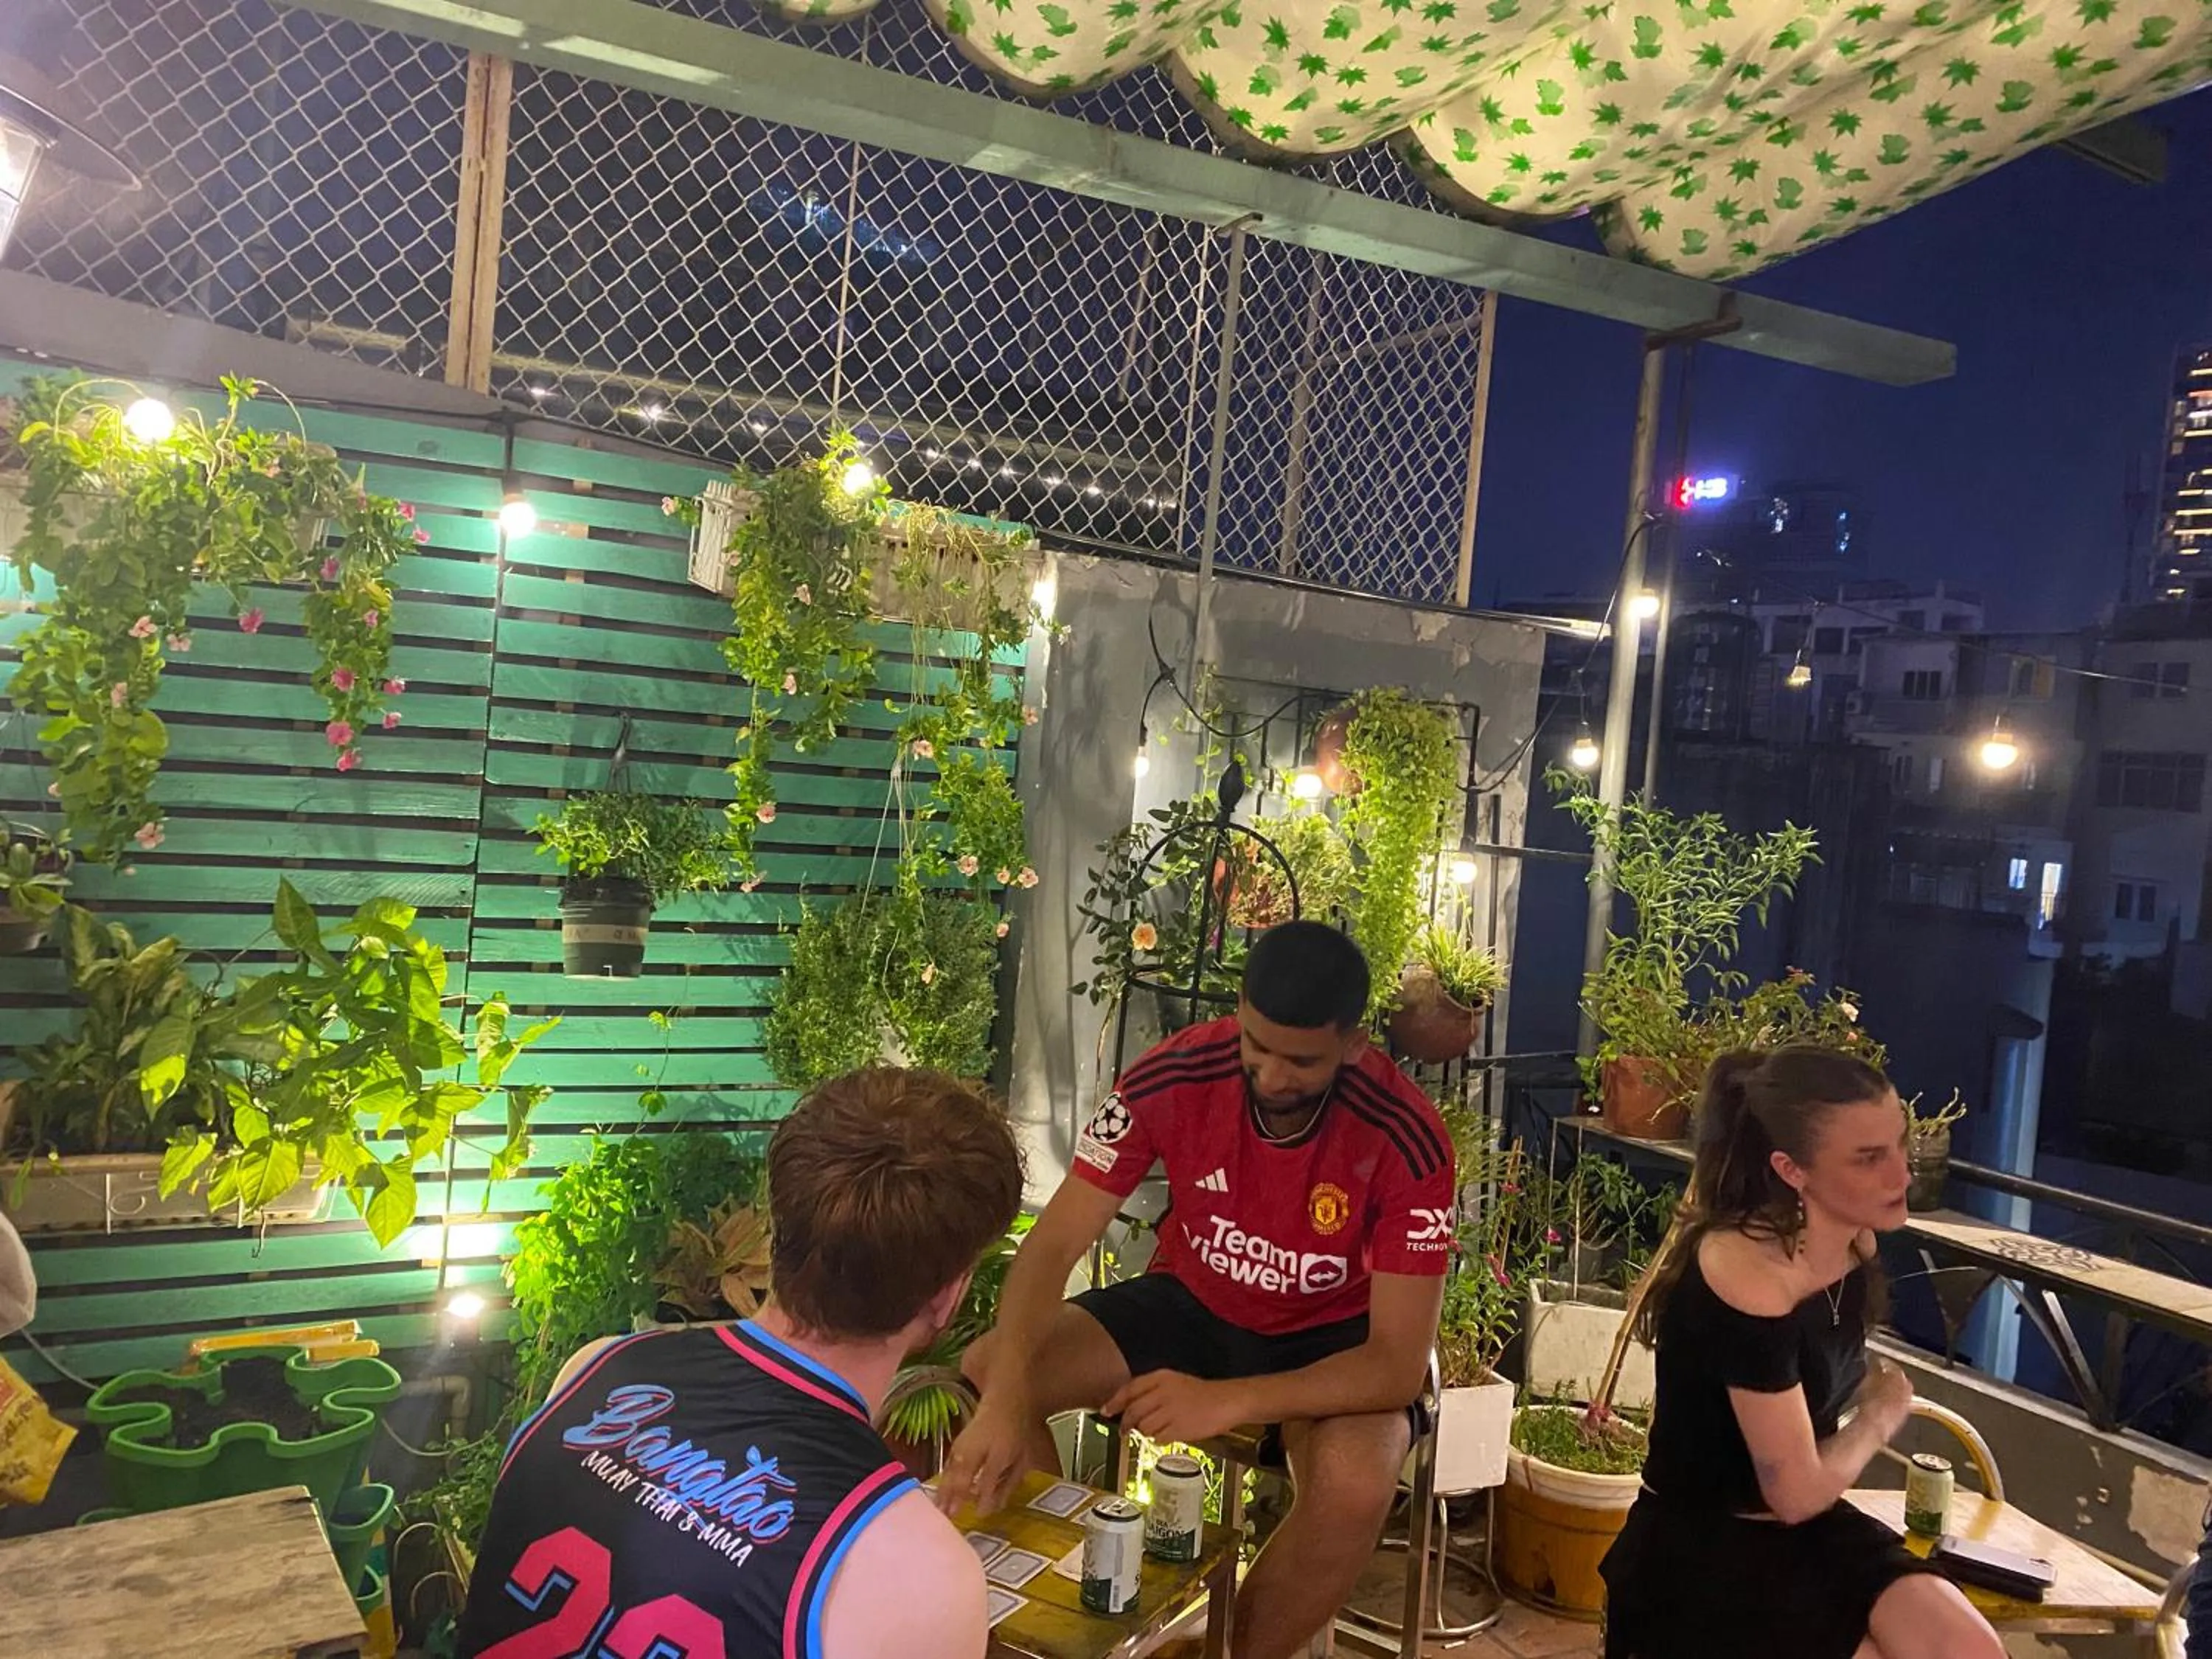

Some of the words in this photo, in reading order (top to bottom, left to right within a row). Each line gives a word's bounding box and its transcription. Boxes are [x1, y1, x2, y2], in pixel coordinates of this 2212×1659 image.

[1210, 1214, 1297, 1275] Team
[563, 1384, 797, 1544] Bangtao
[580, 1450, 639, 1492] MUAY
[634, 1481, 683, 1523] THAI
[697, 1523, 753, 1568] MMA
